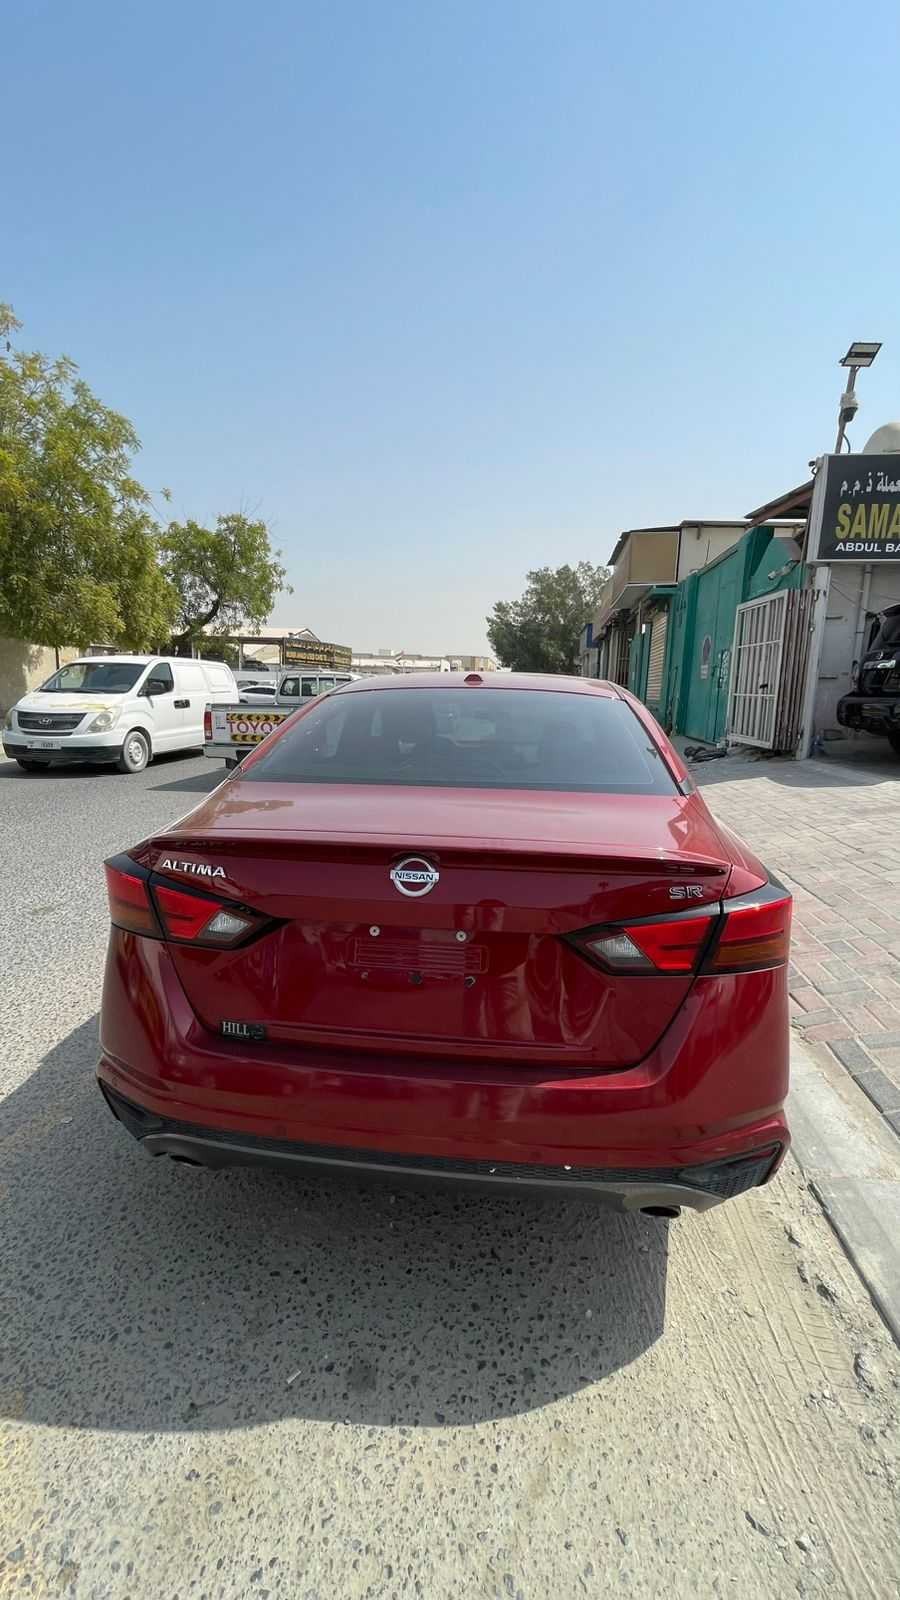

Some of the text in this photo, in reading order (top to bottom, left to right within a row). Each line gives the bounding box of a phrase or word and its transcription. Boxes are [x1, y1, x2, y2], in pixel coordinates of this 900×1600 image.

[835, 503, 900, 539] SAMA
[835, 542, 881, 552] ABDUL
[161, 859, 226, 878] ALTIMA
[394, 871, 433, 881] NISSAN
[669, 885, 703, 899] SR
